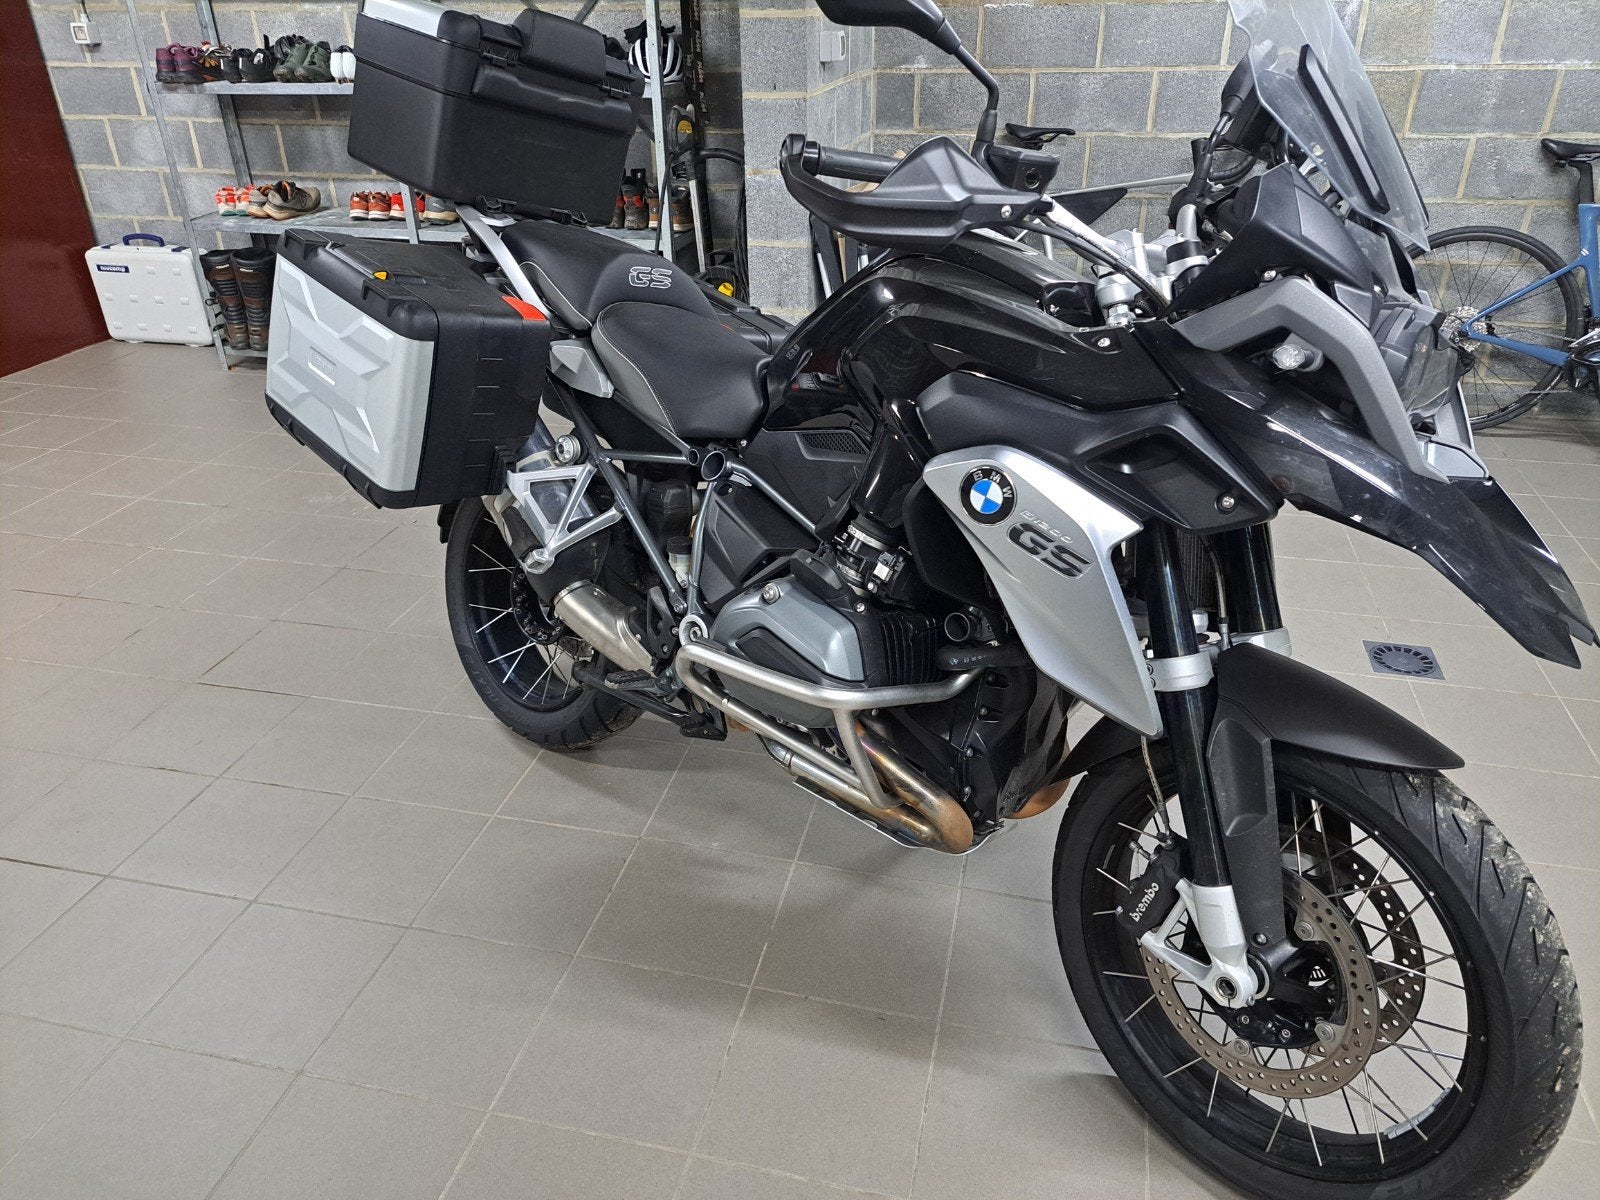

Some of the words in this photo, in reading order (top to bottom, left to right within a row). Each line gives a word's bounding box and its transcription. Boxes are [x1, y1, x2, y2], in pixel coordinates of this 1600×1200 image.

[629, 266, 672, 288] GS
[1008, 522, 1091, 577] GS
[1129, 882, 1159, 922] brembo
